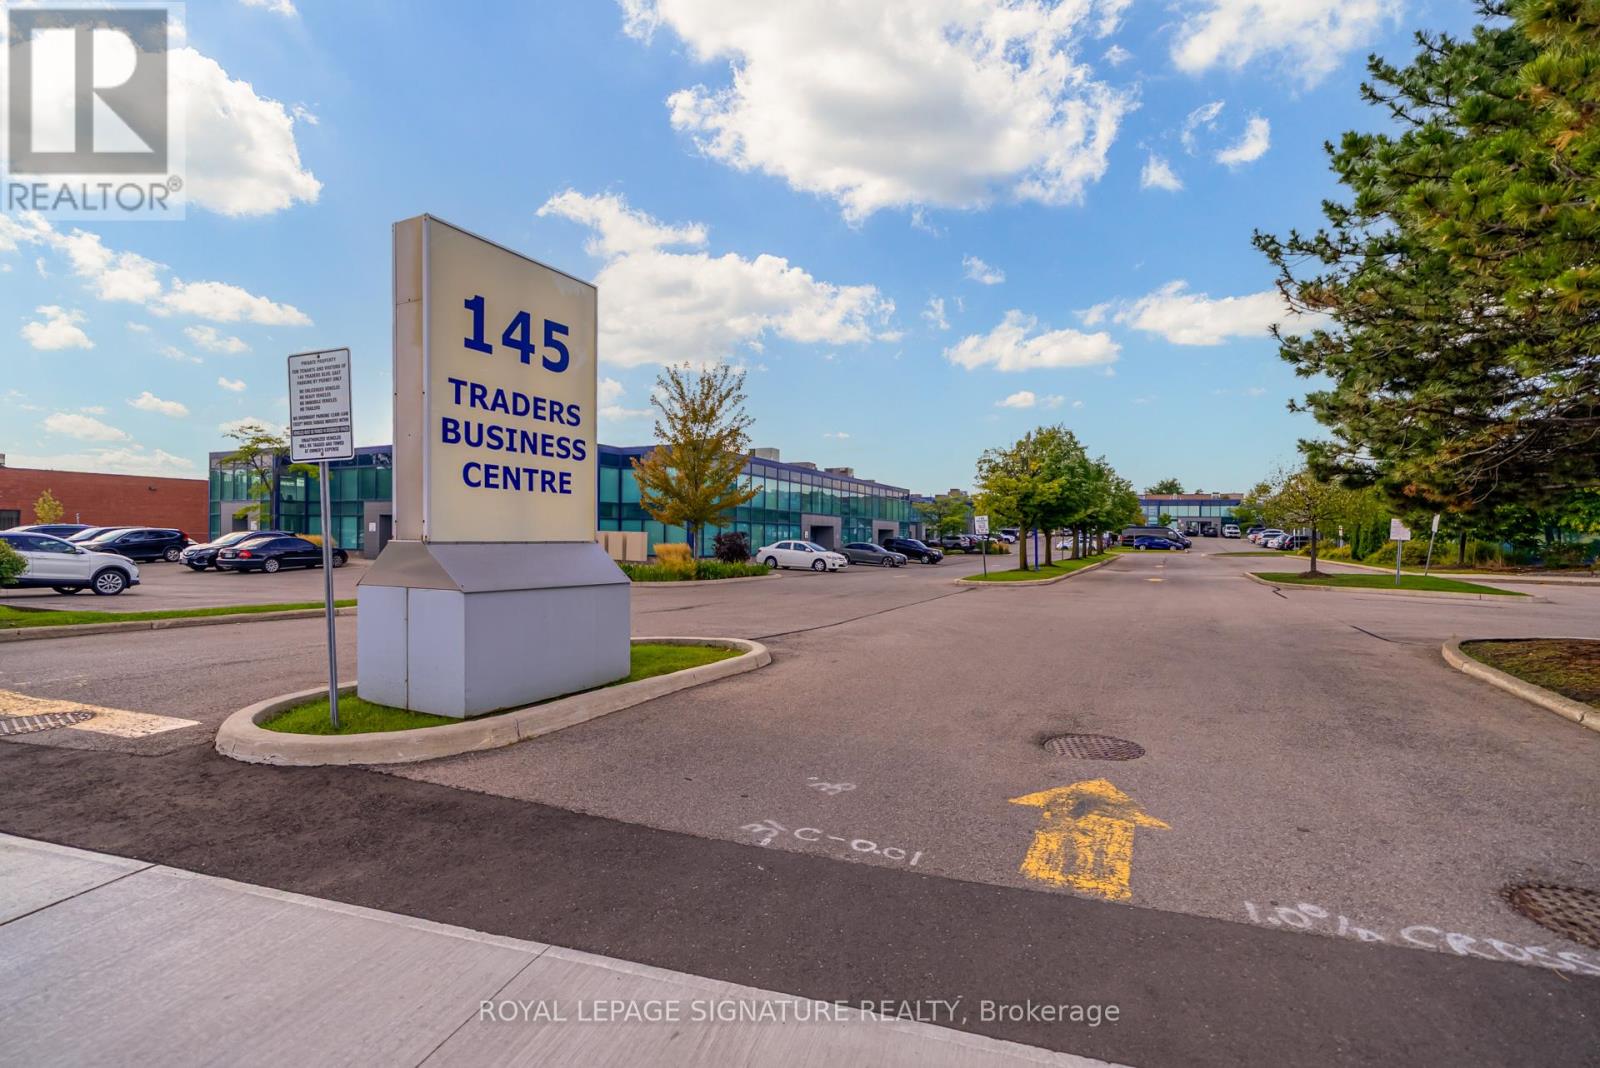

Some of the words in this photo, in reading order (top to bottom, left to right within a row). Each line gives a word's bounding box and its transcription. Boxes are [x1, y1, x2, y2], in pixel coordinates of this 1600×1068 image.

[464, 294, 570, 374] 145
[448, 377, 581, 427] TRADERS
[441, 416, 587, 462] BUSINESS
[462, 461, 573, 495] CENTRE
